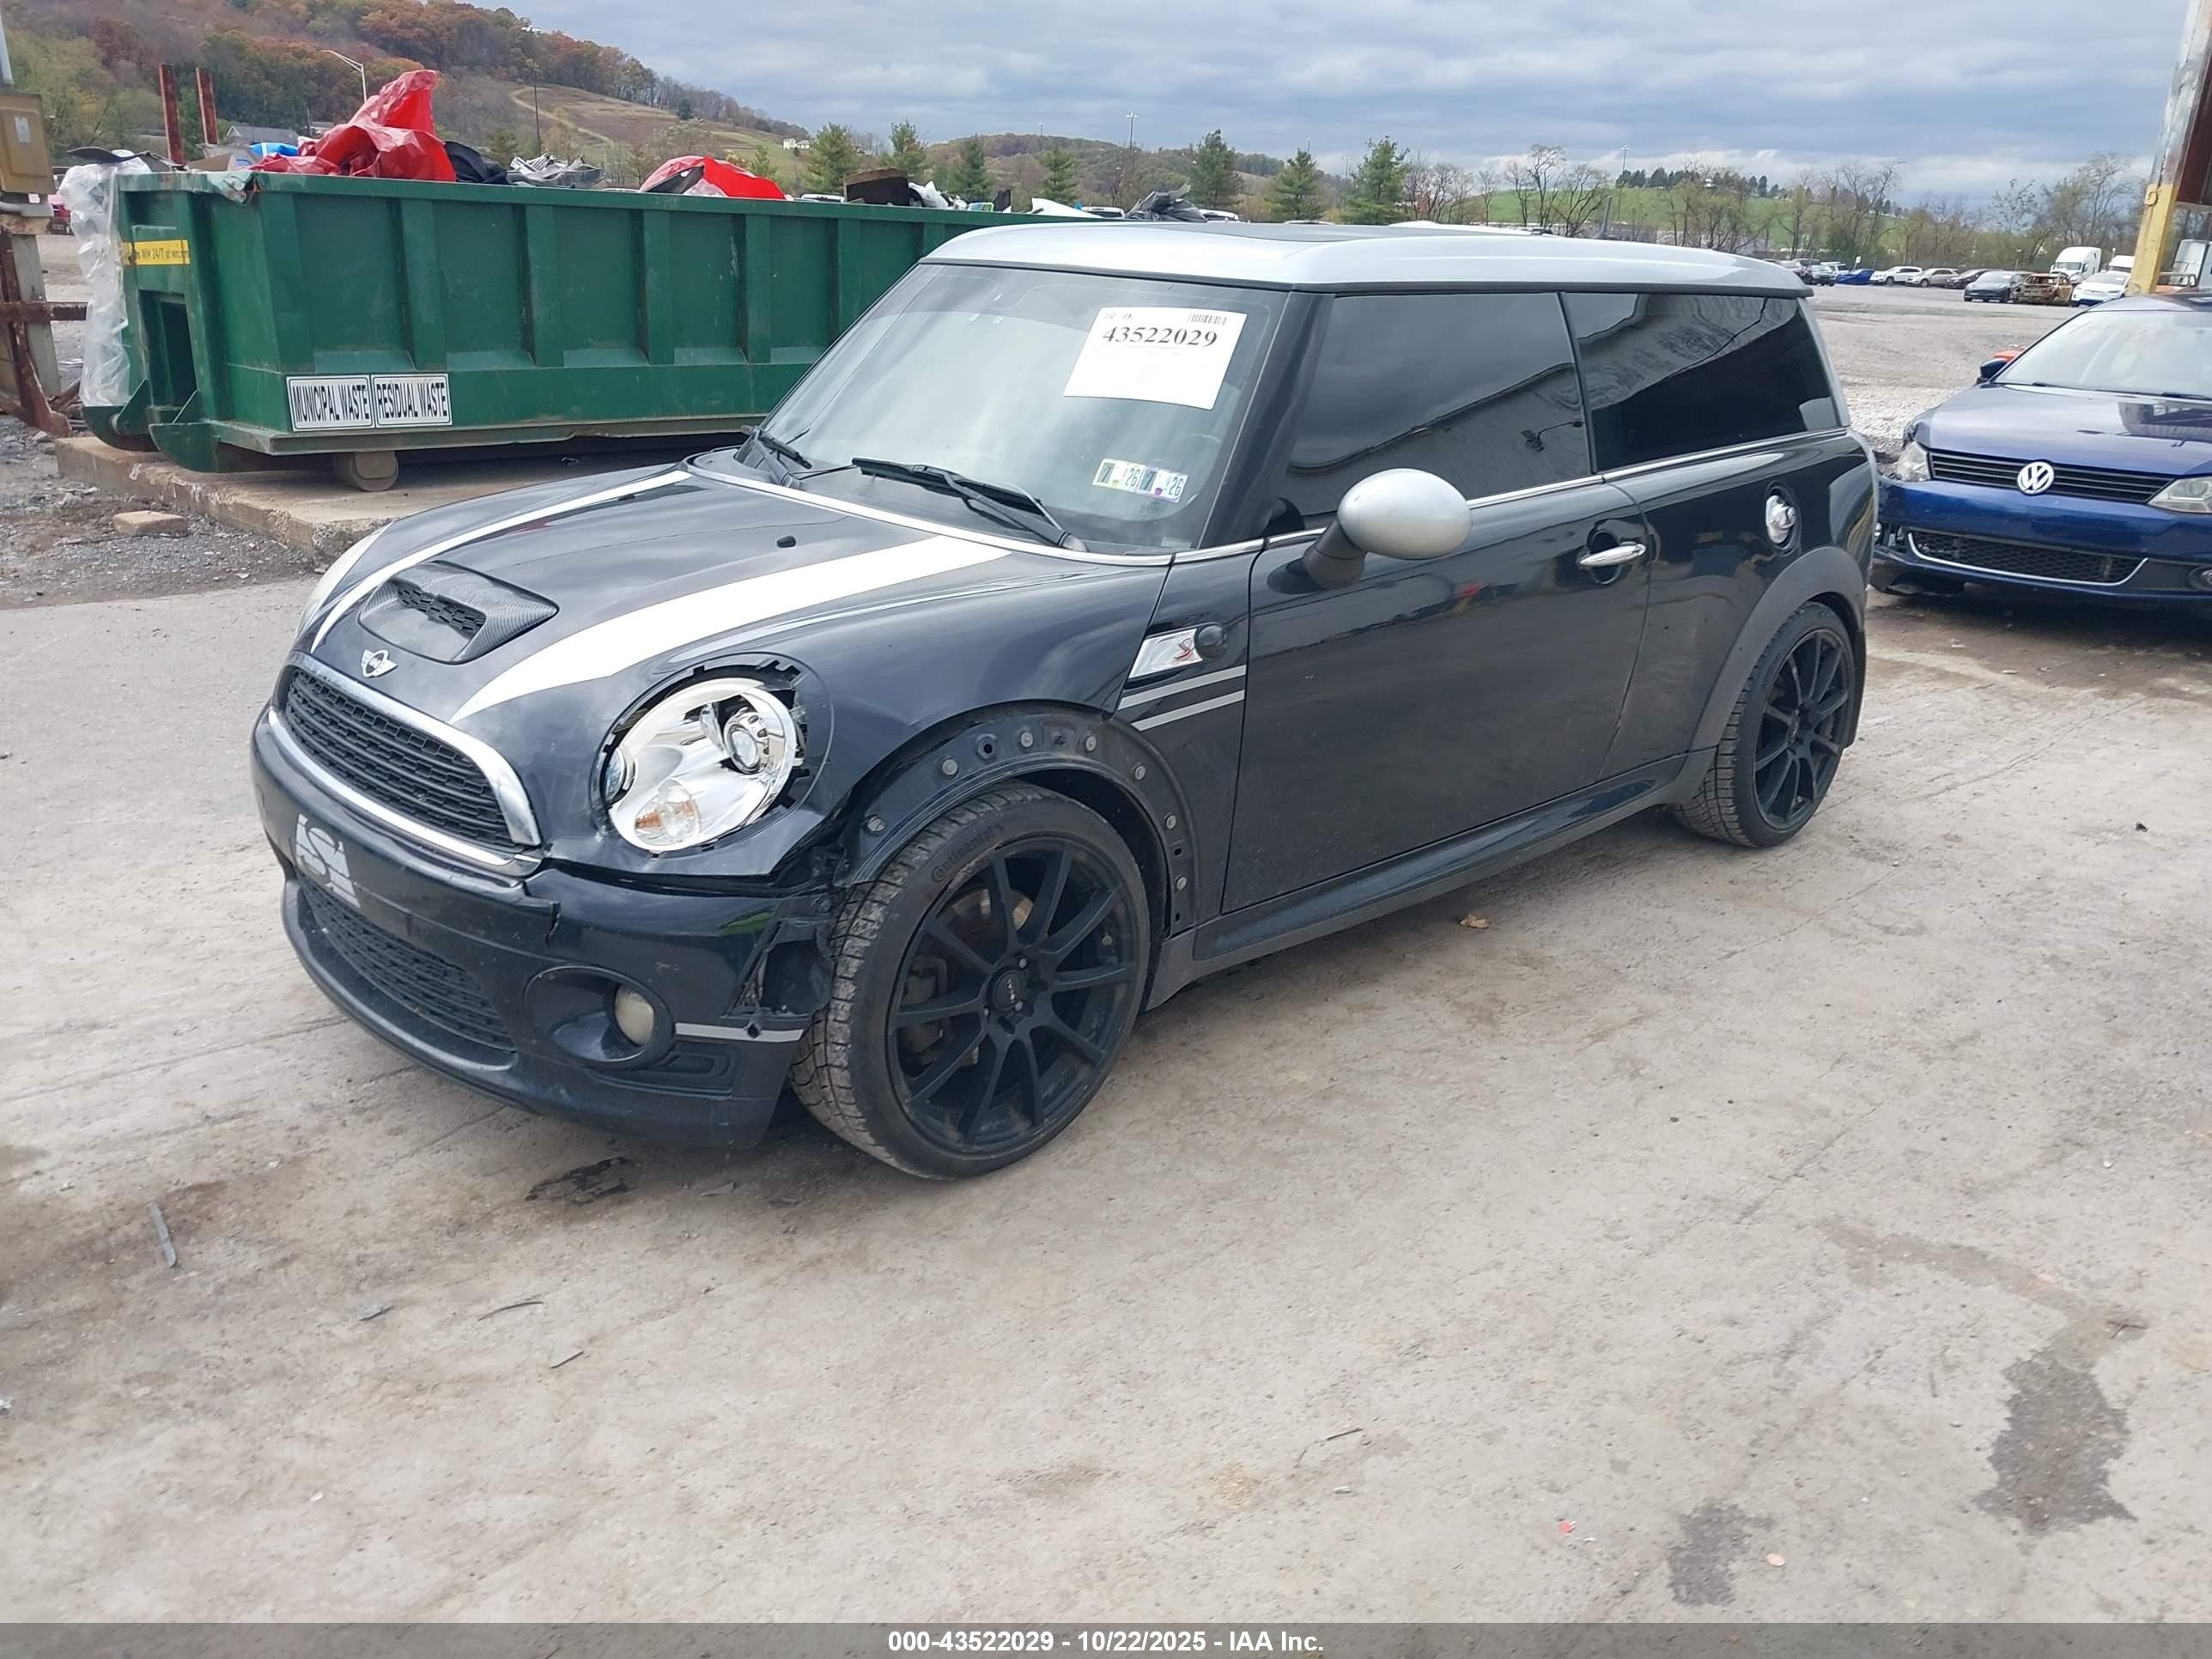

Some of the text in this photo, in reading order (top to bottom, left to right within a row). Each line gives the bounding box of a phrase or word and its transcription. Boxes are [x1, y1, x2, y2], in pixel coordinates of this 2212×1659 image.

[1103, 326, 1218, 347] 43522029
[293, 385, 369, 422] MUNICIPAL WASTE
[376, 382, 447, 419] RESIDUAL WASTE
